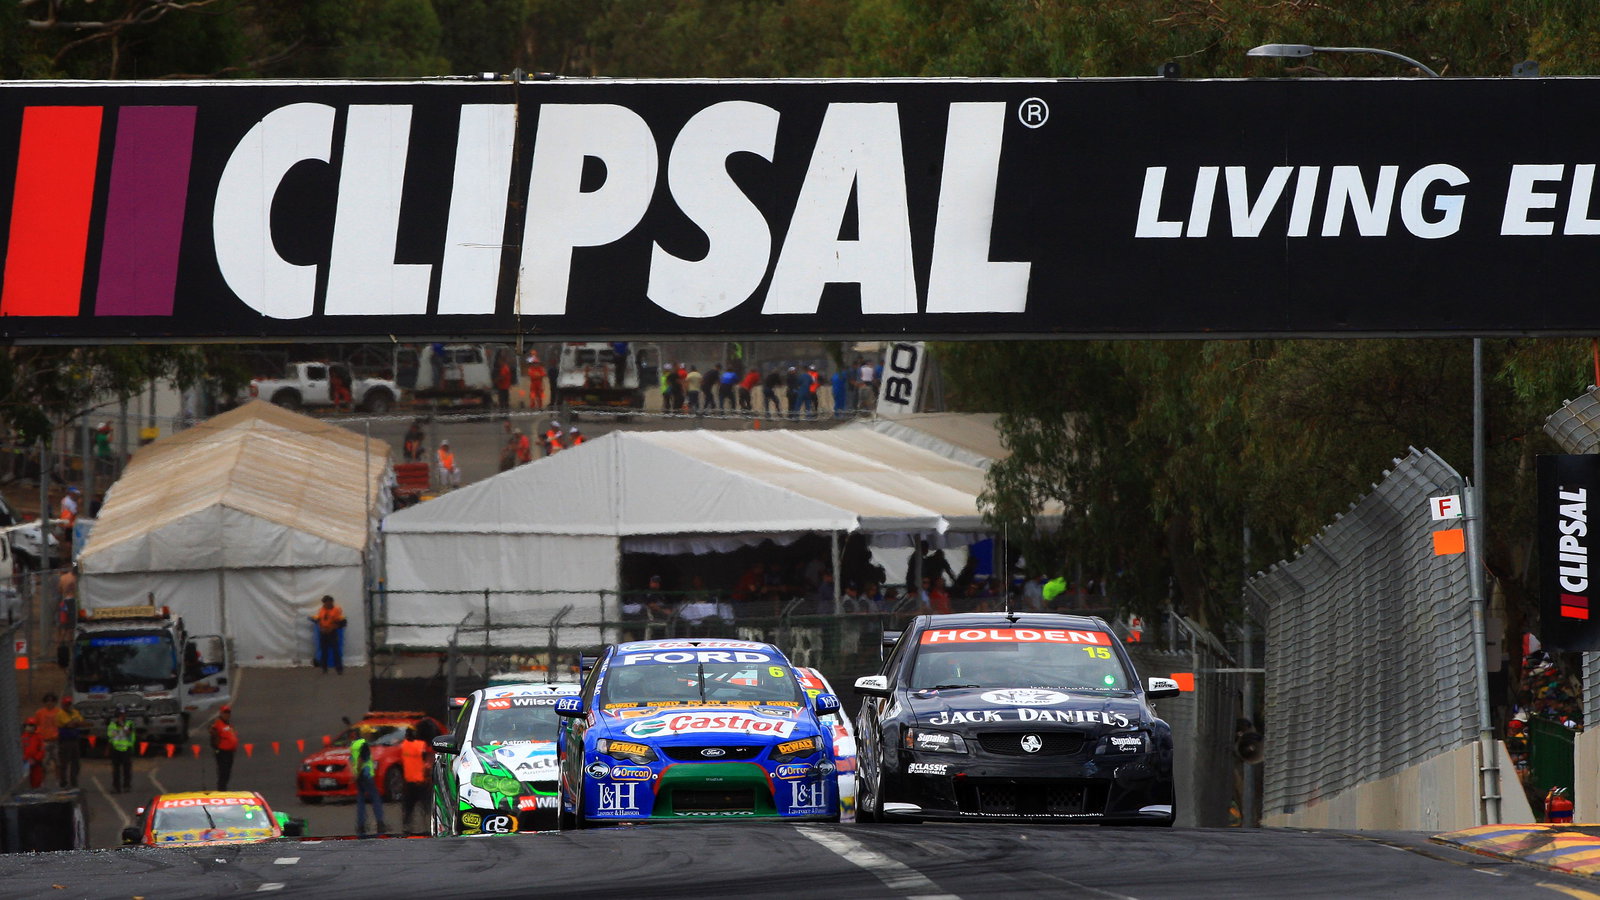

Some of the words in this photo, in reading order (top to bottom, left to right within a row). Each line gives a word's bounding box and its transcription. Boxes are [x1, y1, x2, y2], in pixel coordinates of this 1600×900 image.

[1135, 163, 1470, 239] LIVING
[213, 100, 1032, 319] CLIPSAL
[1438, 498, 1452, 516] F
[1558, 487, 1588, 593] CLIPSAL
[930, 629, 1099, 643] HOLDEN
[623, 651, 771, 666] FORD
[1082, 646, 1112, 660] 15
[768, 666, 785, 678] 6
[513, 698, 558, 706] Wilso
[669, 715, 785, 734] Castrol
[929, 710, 1003, 726] JACK
[621, 768, 649, 777] Orrcon
[787, 766, 809, 775] Orrco
[915, 763, 948, 772] CLASSIC
[163, 799, 256, 808] HOLDEN
